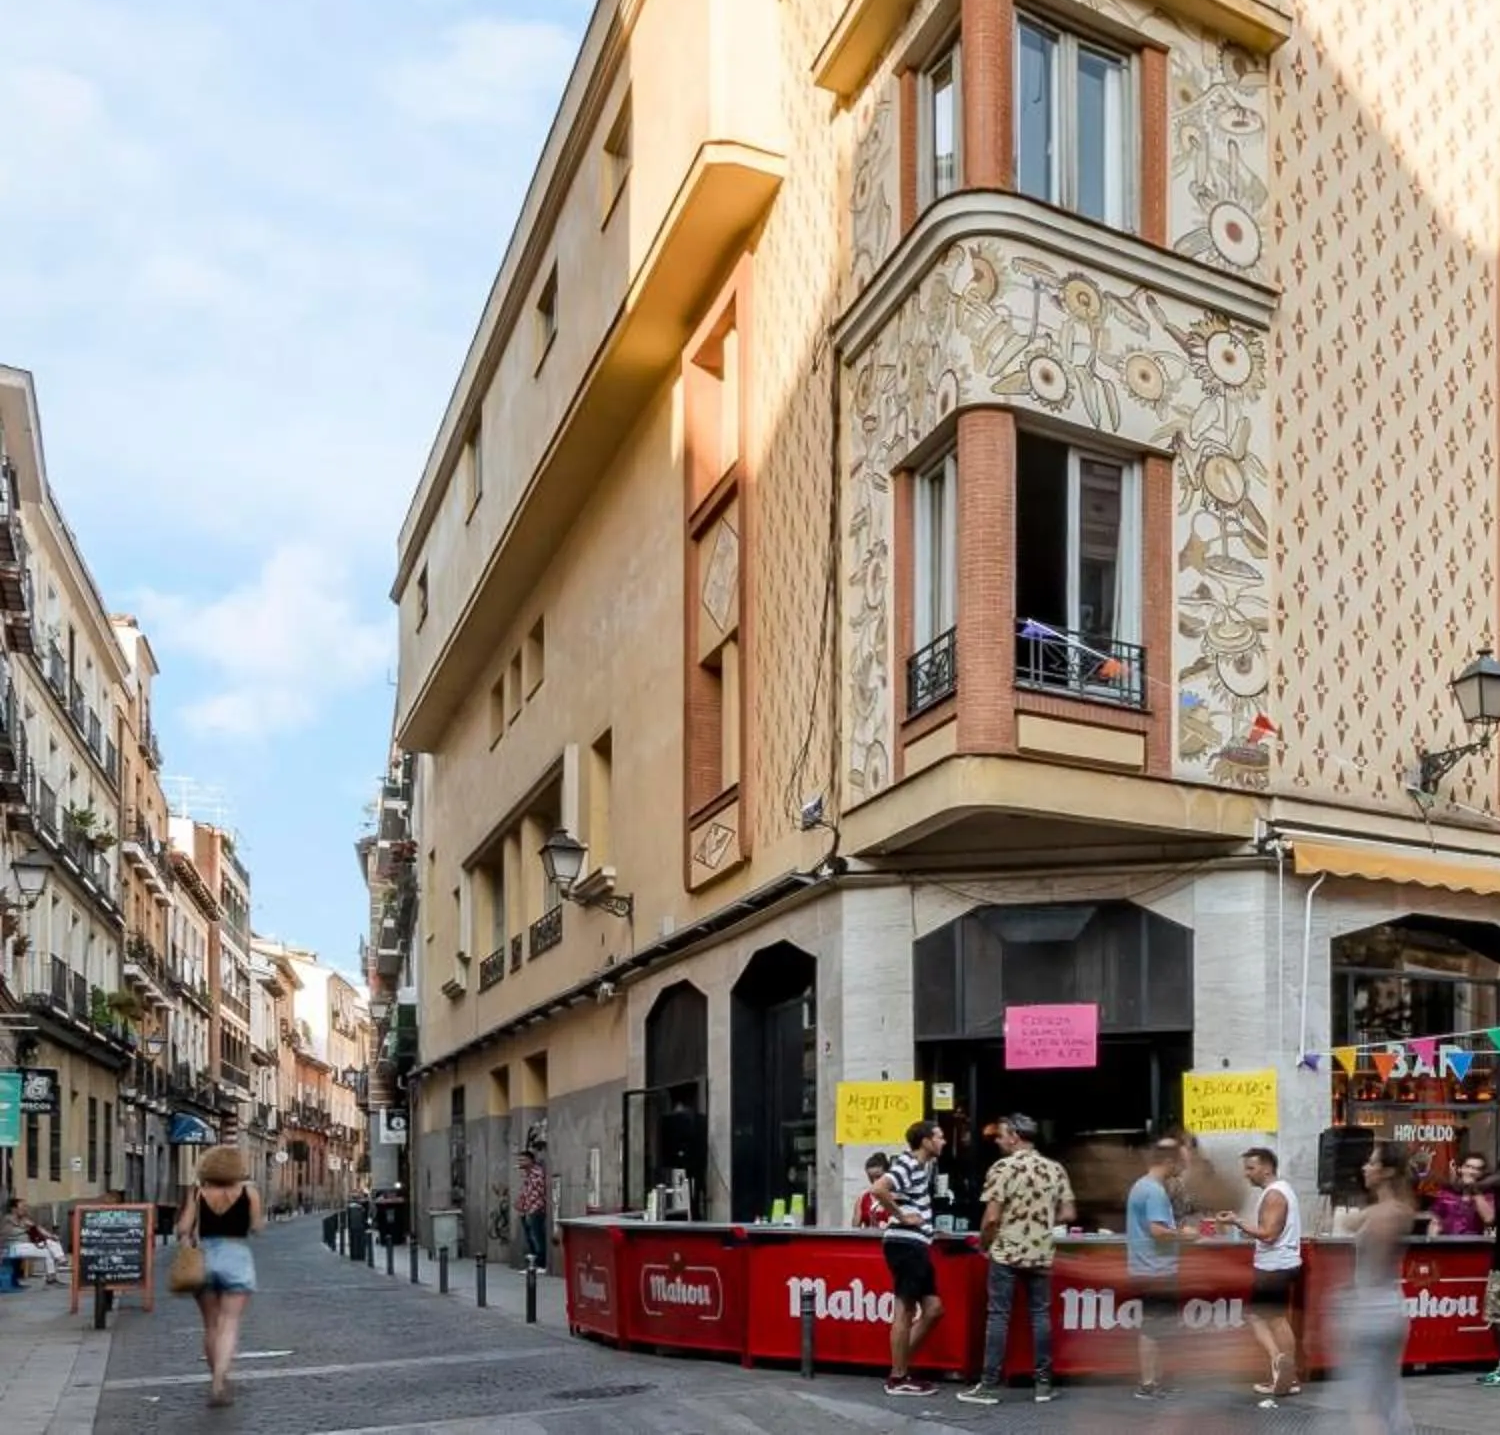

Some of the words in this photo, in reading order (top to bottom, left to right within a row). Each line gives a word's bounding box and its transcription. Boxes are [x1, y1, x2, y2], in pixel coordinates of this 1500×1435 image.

[1394, 1125, 1416, 1142] HAY
[1417, 1125, 1454, 1142] CALDO
[649, 1274, 711, 1306] Mahou
[786, 1276, 922, 1324] Maho
[1400, 1288, 1480, 1318] ahou
[1060, 1288, 1246, 1330] Maou
